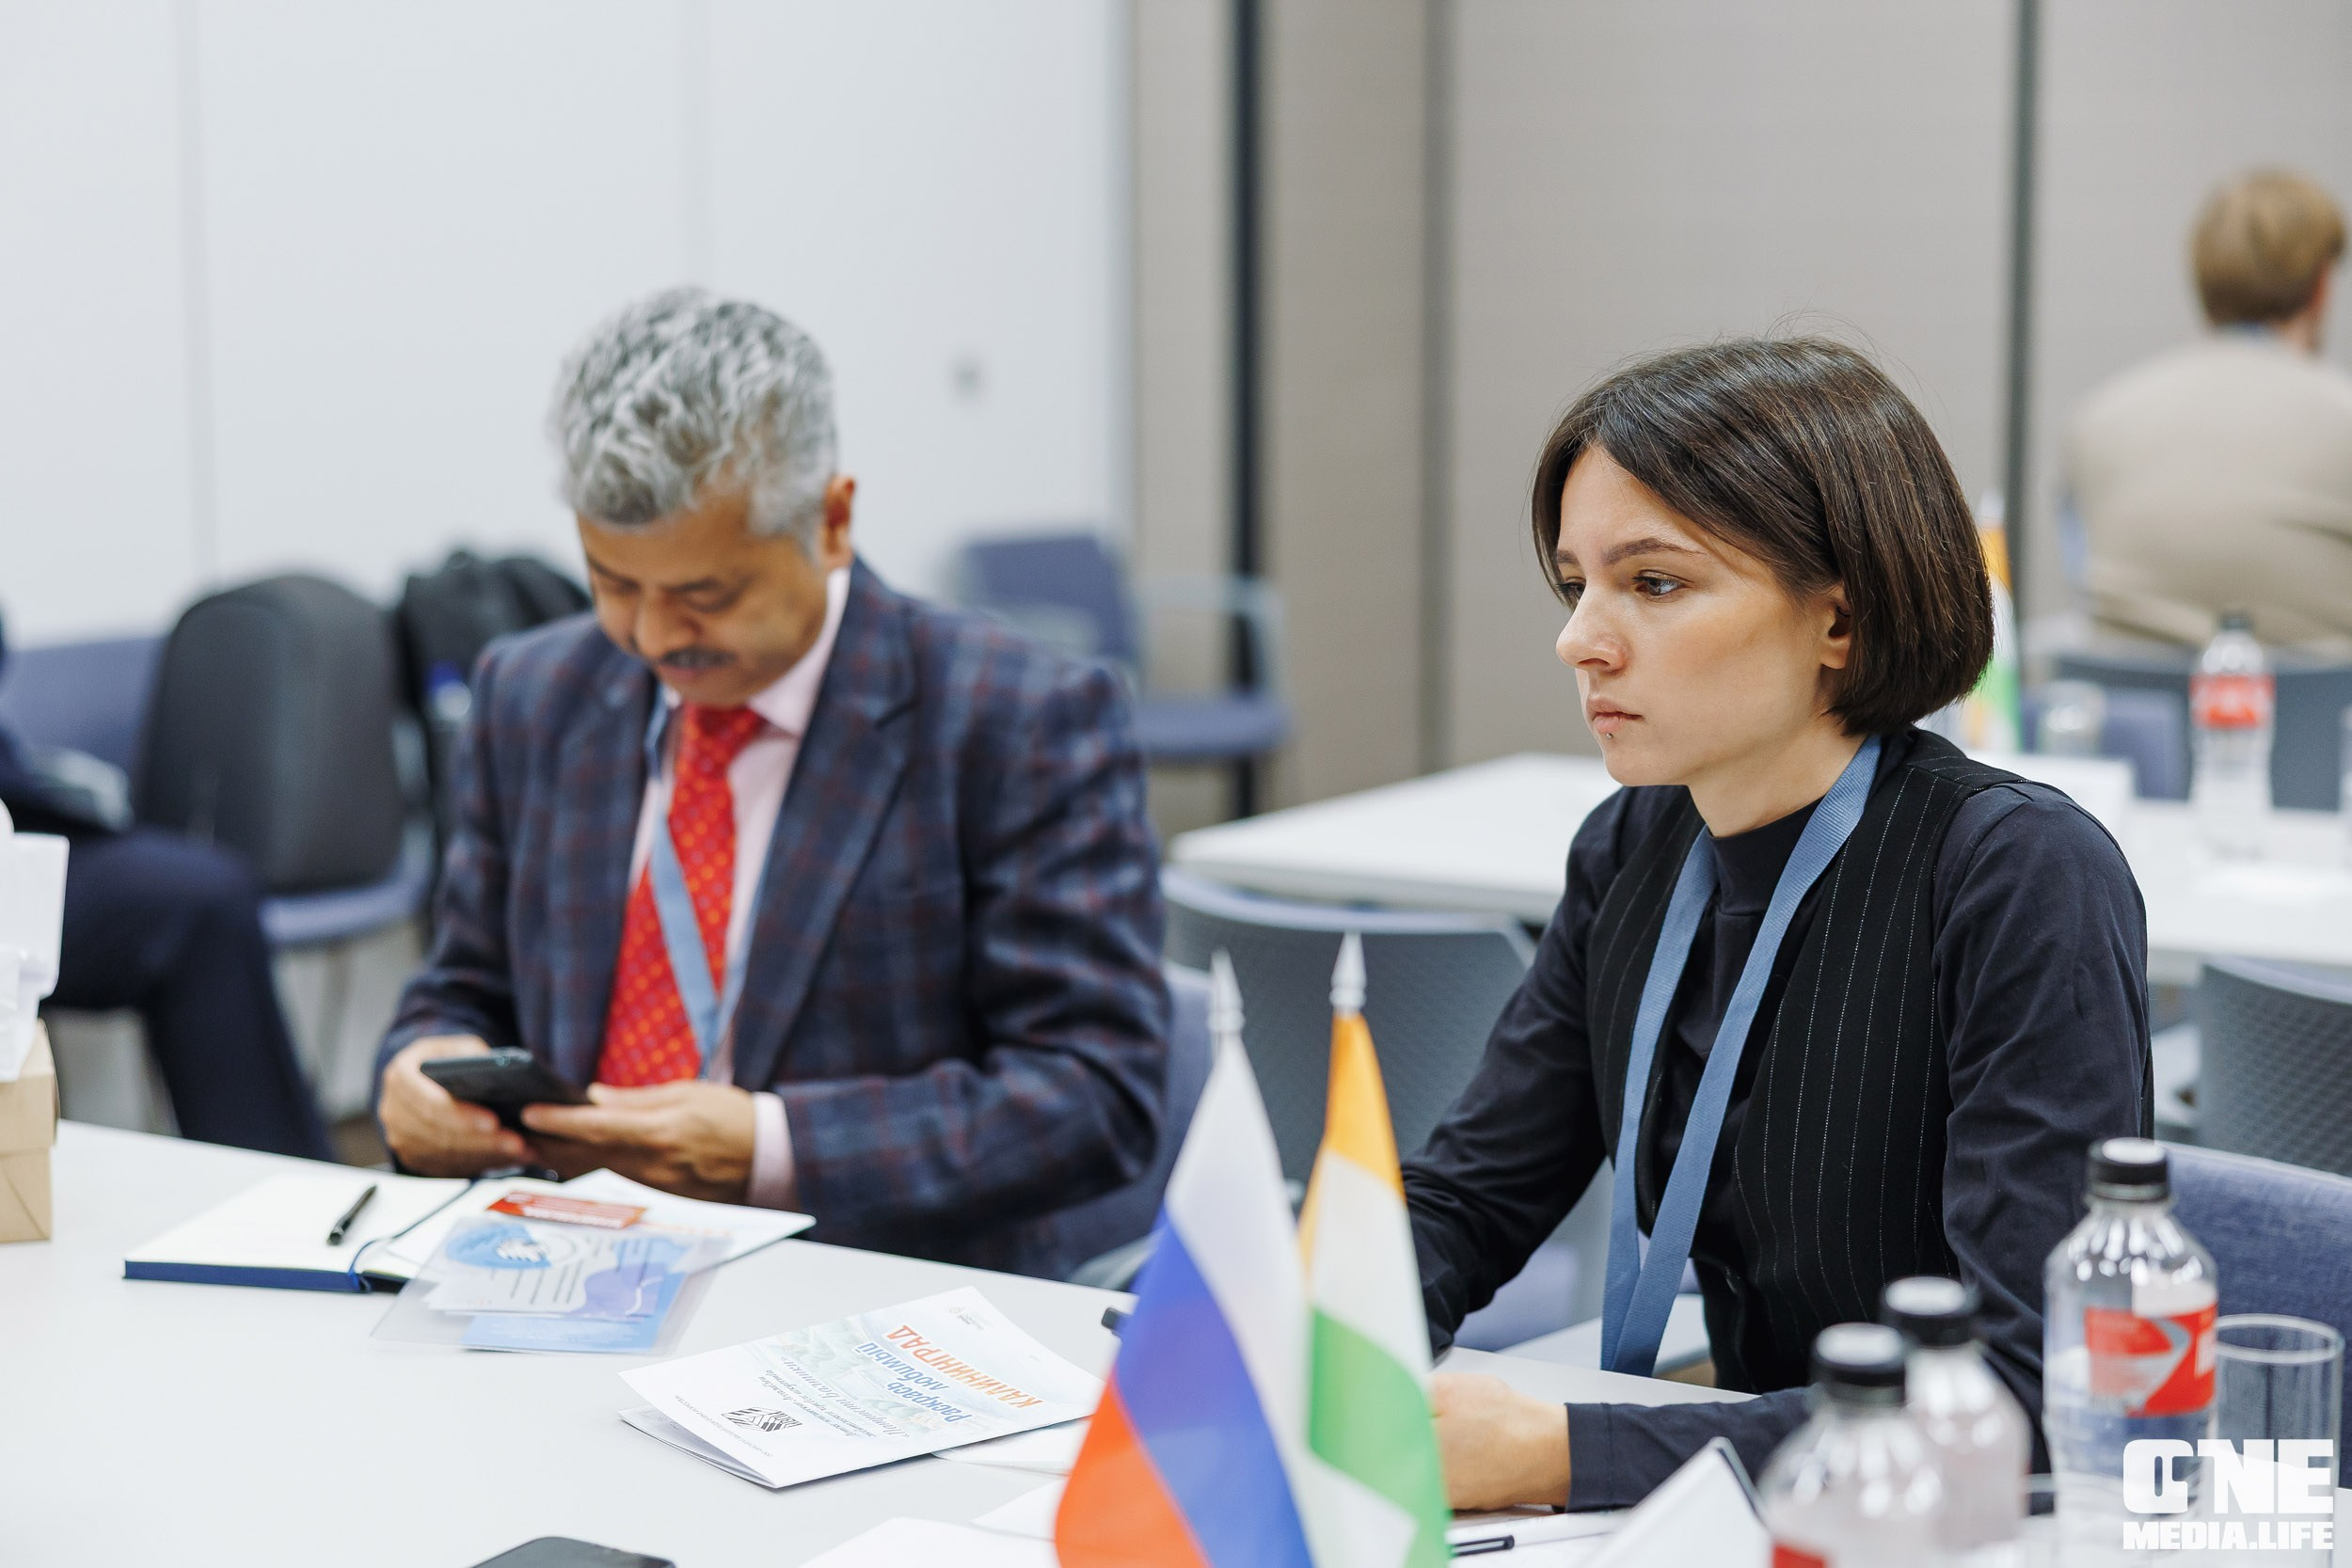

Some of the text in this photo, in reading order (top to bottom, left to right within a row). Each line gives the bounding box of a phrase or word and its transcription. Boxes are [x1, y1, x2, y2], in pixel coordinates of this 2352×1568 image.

[854, 1342, 948, 1387] любимый
[886, 1324, 1039, 1407] КАЛИНИНГРАД
[886, 1382, 965, 1422] Раскрась
